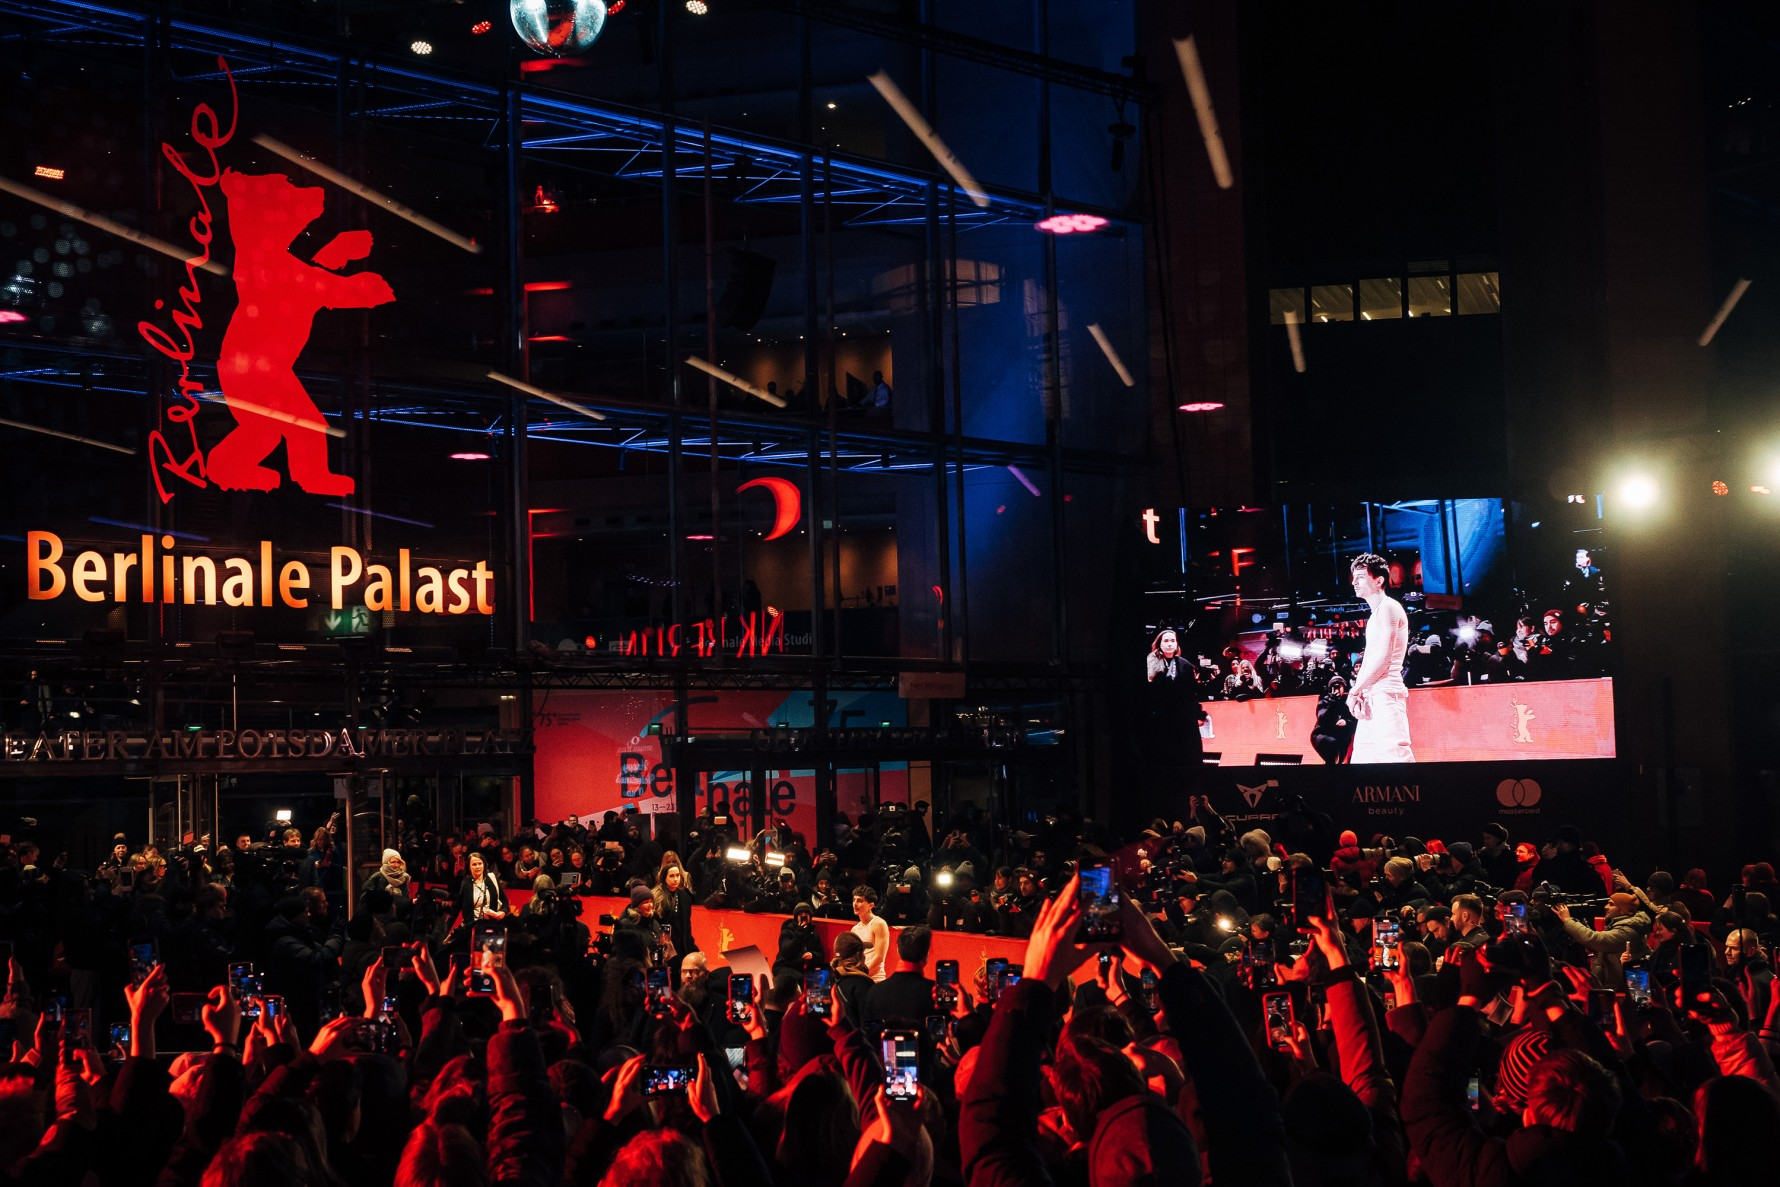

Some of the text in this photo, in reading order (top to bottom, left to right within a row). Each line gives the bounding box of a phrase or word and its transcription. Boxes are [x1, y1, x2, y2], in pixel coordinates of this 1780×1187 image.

[138, 55, 239, 503] Berlinale
[27, 530, 494, 615] Berlinale Palast
[143, 729, 209, 760] AM
[215, 728, 432, 759] POTSDAMER
[620, 752, 796, 816] Benae
[1351, 785, 1420, 803] ARMANI
[1367, 806, 1404, 816] beauty
[1498, 807, 1542, 816] mastercard
